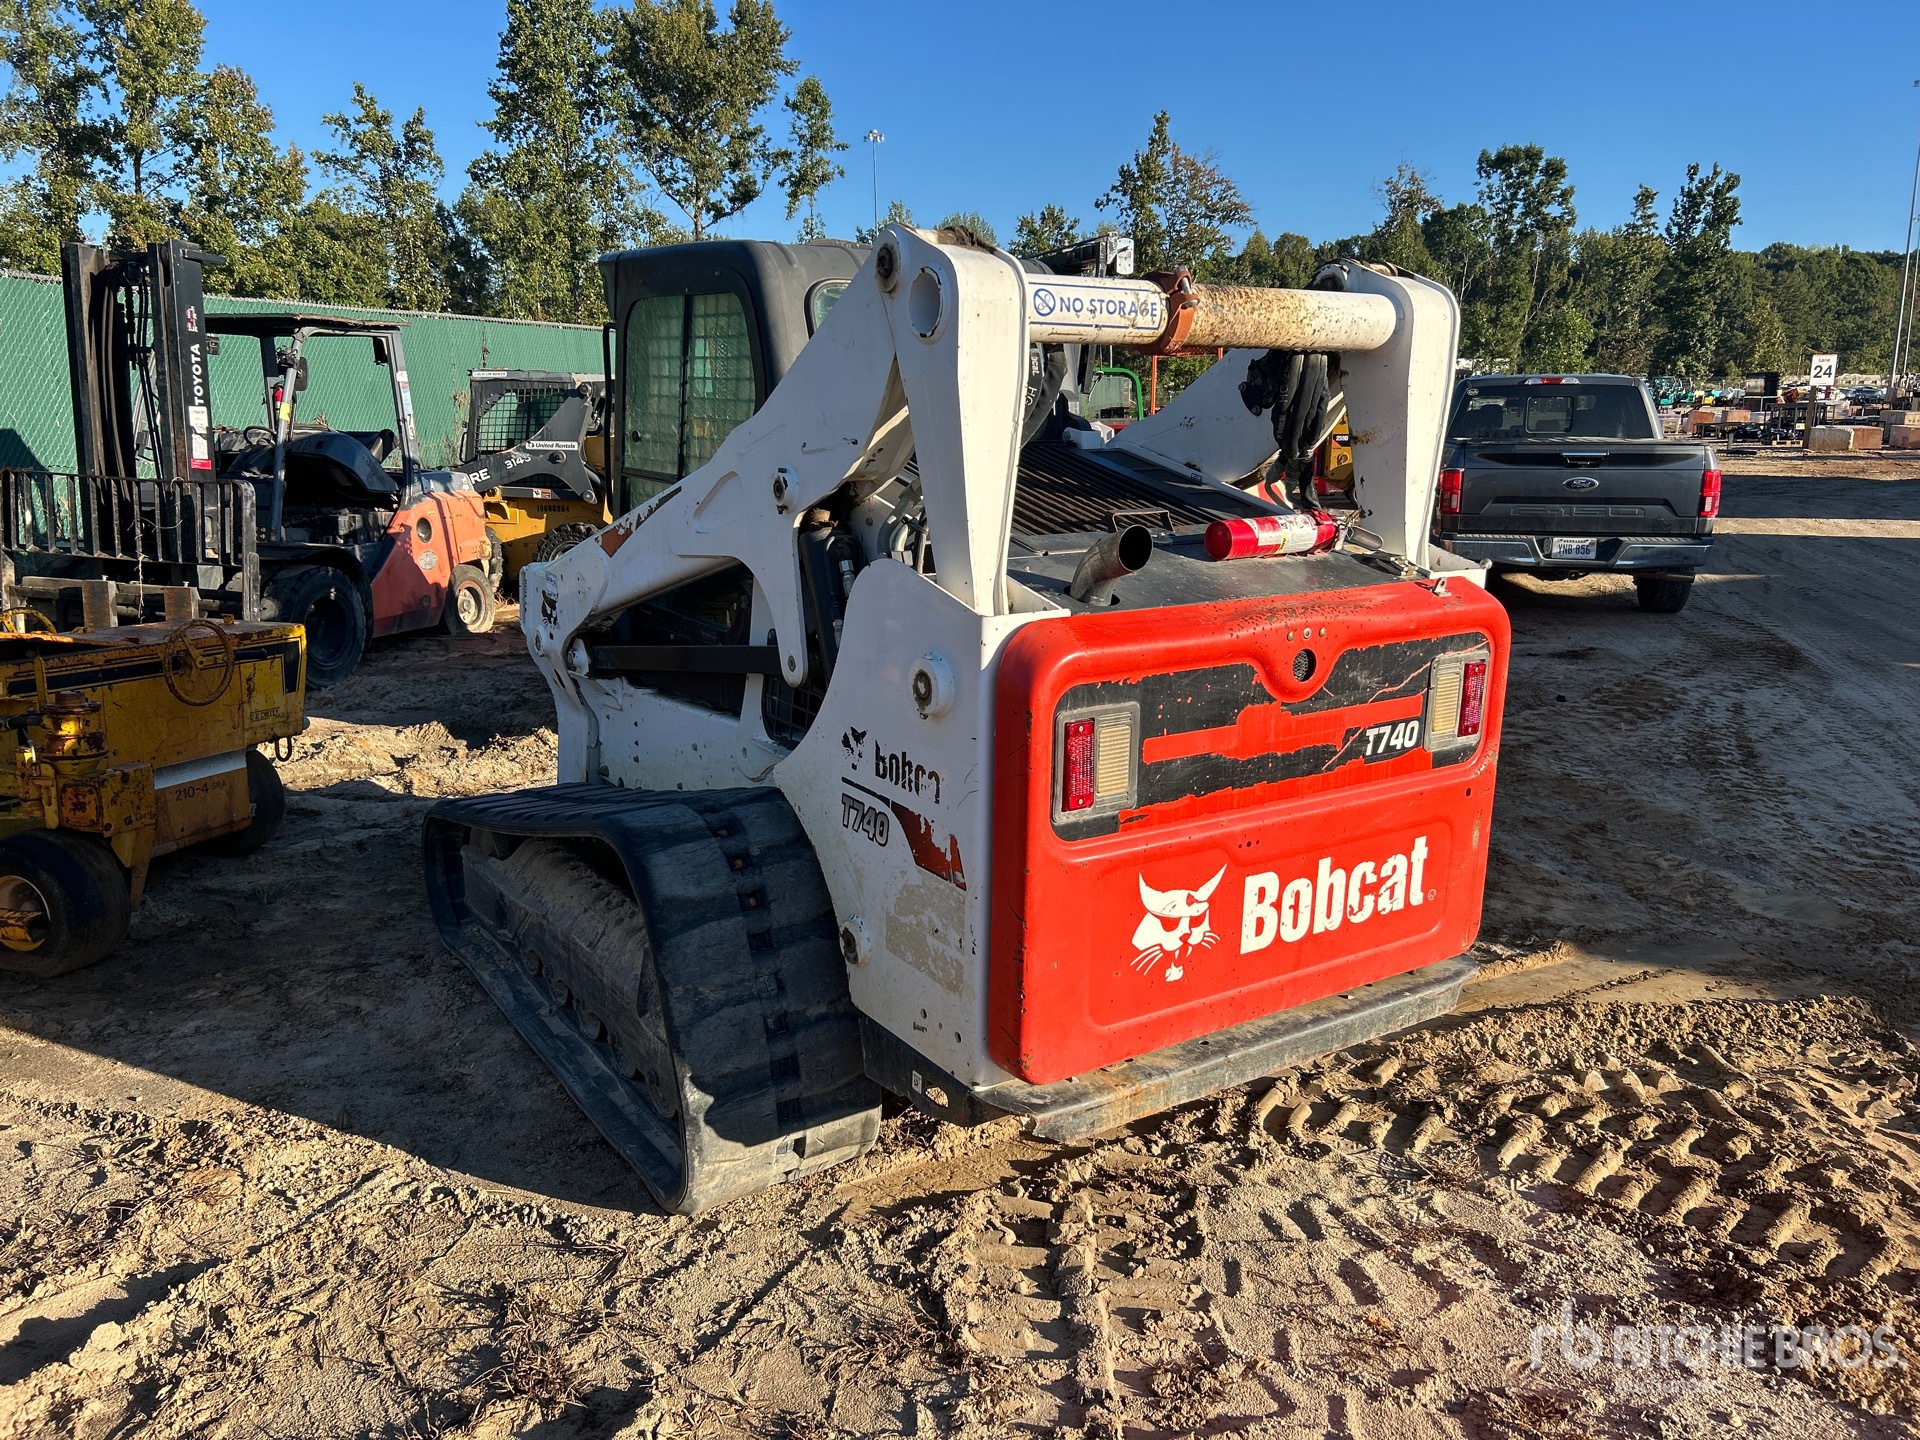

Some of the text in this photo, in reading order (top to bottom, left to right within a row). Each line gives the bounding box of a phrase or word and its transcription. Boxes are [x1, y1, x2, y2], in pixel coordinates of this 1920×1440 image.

[1060, 296, 1158, 317] NO STORAGE
[190, 343, 205, 406] TOYOTA
[1813, 364, 1833, 378] 24
[1510, 506, 1646, 517] F-150
[1575, 544, 1591, 555] 856
[1365, 720, 1419, 756] T740
[175, 782, 209, 802] 210-4
[841, 792, 890, 847] T740
[1240, 835, 1429, 955] Bobcat
